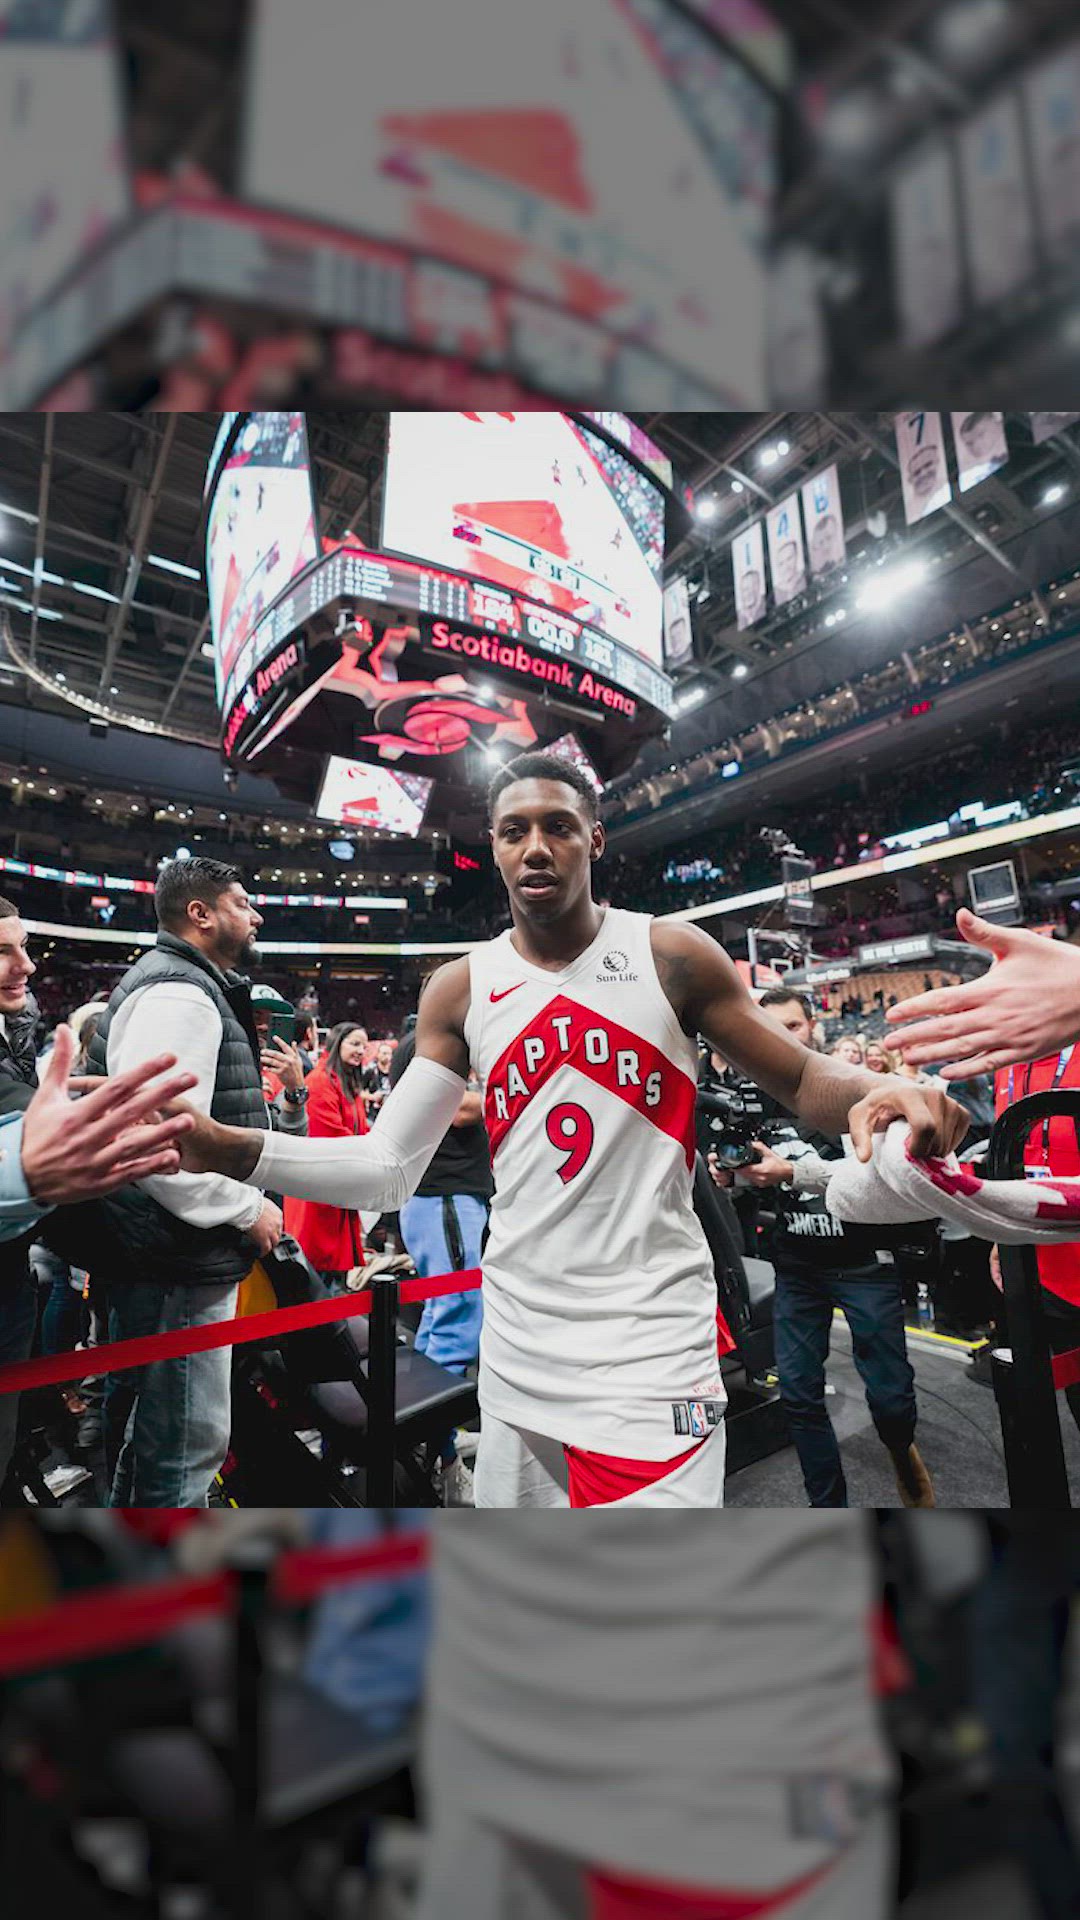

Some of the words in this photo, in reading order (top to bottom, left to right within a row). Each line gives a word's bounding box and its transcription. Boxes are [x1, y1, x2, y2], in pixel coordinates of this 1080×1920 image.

[908, 411, 925, 446] 7
[256, 643, 299, 697] Arena
[431, 621, 575, 688] Scotiabank
[578, 673, 636, 716] Arena
[595, 973, 617, 983] Sun
[619, 972, 638, 982] Life
[493, 1015, 662, 1121] RAPTORS
[546, 1101, 594, 1185] 9
